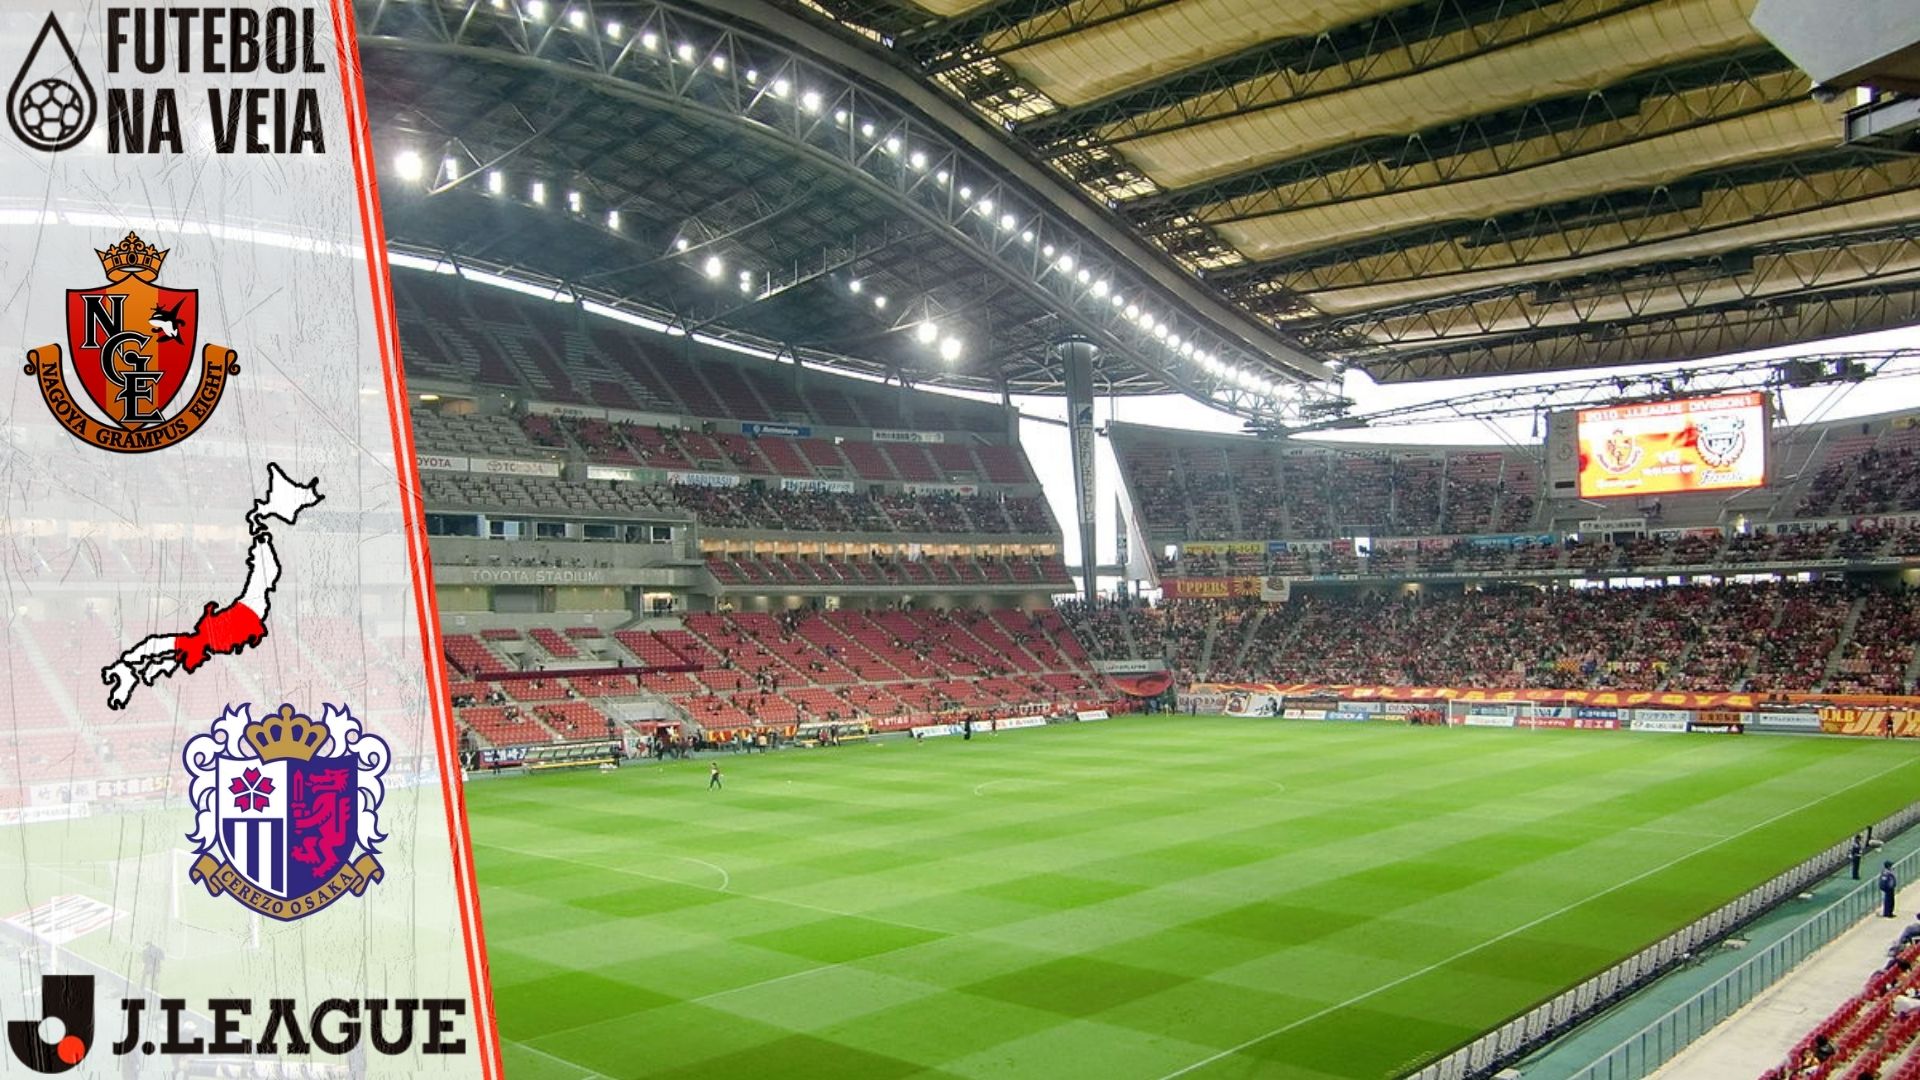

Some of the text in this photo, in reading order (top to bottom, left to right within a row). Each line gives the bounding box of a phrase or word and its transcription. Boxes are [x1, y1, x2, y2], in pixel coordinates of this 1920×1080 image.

[416, 457, 451, 469] OYOTA
[472, 570, 600, 582] TOYOTA STADIUM
